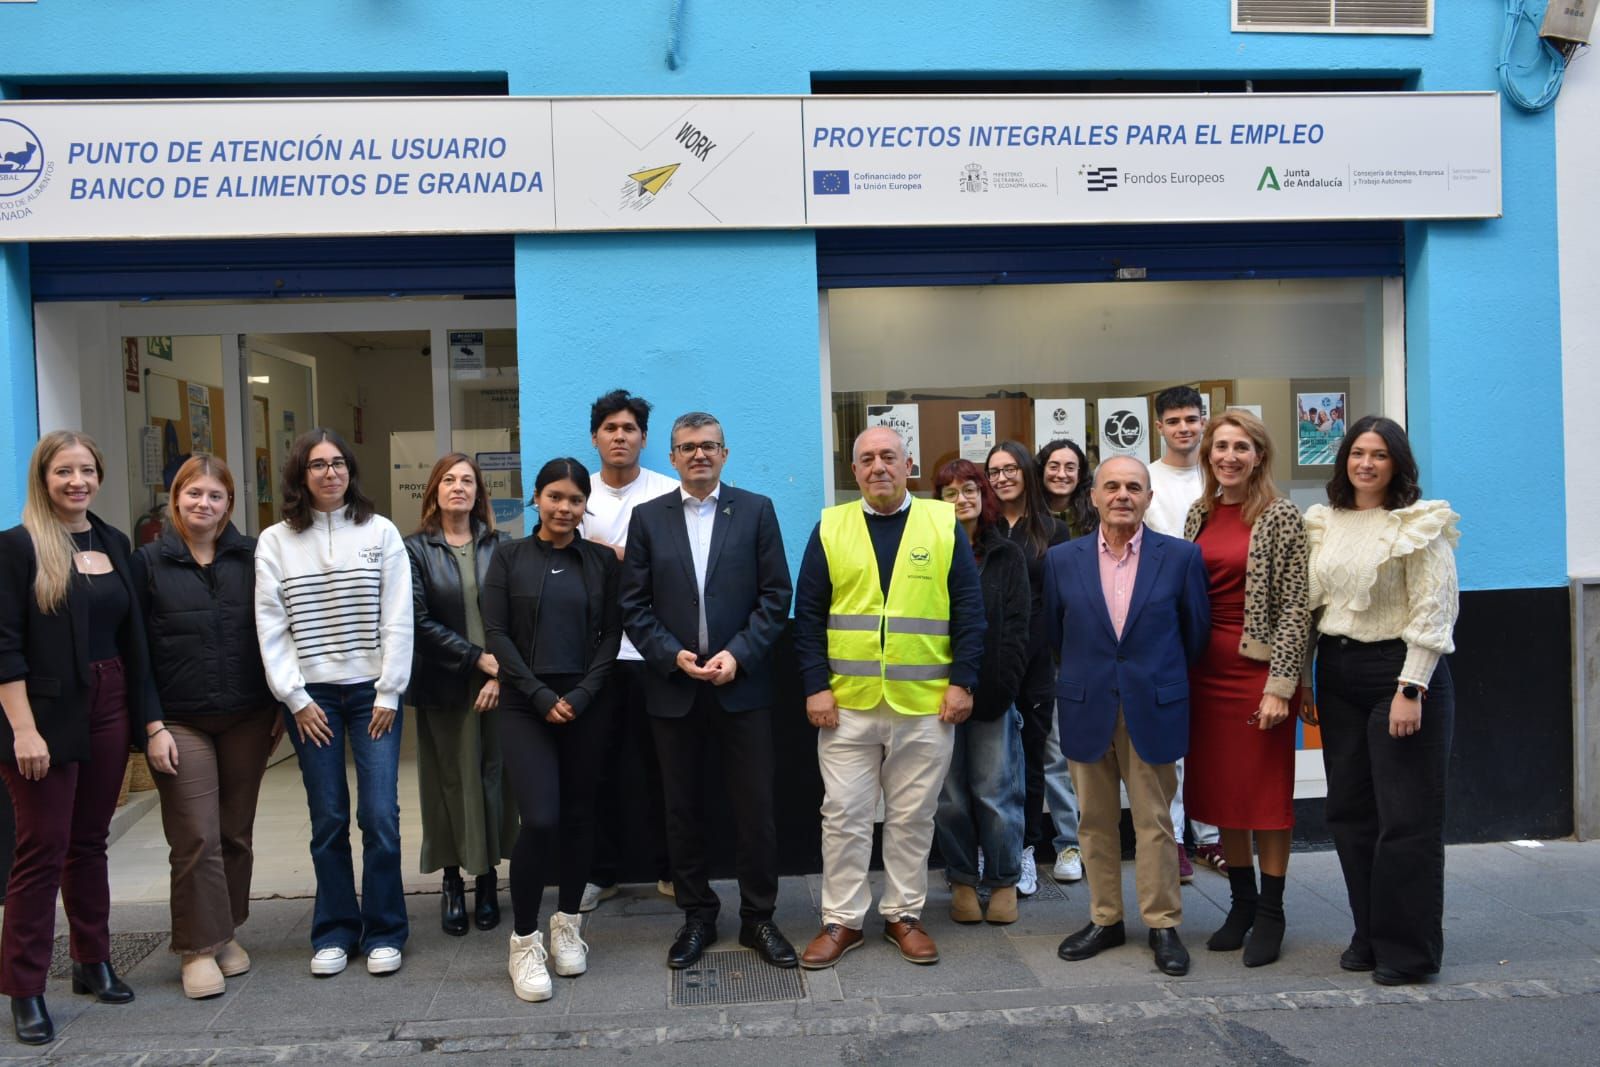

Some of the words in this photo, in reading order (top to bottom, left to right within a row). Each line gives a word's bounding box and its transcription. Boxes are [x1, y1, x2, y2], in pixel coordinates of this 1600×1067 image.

[675, 121, 717, 162] WORK
[813, 126, 962, 148] PROYECTOS
[968, 125, 1119, 147] INTEGRALES
[1126, 124, 1187, 146] PARA
[1195, 124, 1222, 145] EL
[1230, 123, 1324, 145] EMPLEO
[68, 141, 159, 164] PUNTO
[167, 140, 203, 163] DE
[210, 134, 343, 163] ATENCIÓN
[349, 138, 382, 161] AL
[391, 137, 507, 160] USUARIO
[853, 172, 905, 181] Cofinanciado
[907, 174, 922, 182] por
[1124, 172, 1168, 184] Fondos
[1170, 172, 1225, 187] Europeos
[1283, 169, 1310, 178] Junta
[69, 177, 165, 200] BANCO
[174, 176, 210, 198] DE
[216, 174, 367, 198] ALIMENTOS
[375, 173, 410, 195] DE
[418, 171, 544, 195] GRANADA
[854, 182, 862, 190] la
[863, 182, 887, 190] Unión
[888, 182, 922, 191] Europea
[1283, 178, 1296, 188] de
[1297, 177, 1343, 188] Andalucía
[0, 207, 32, 221] NADA
